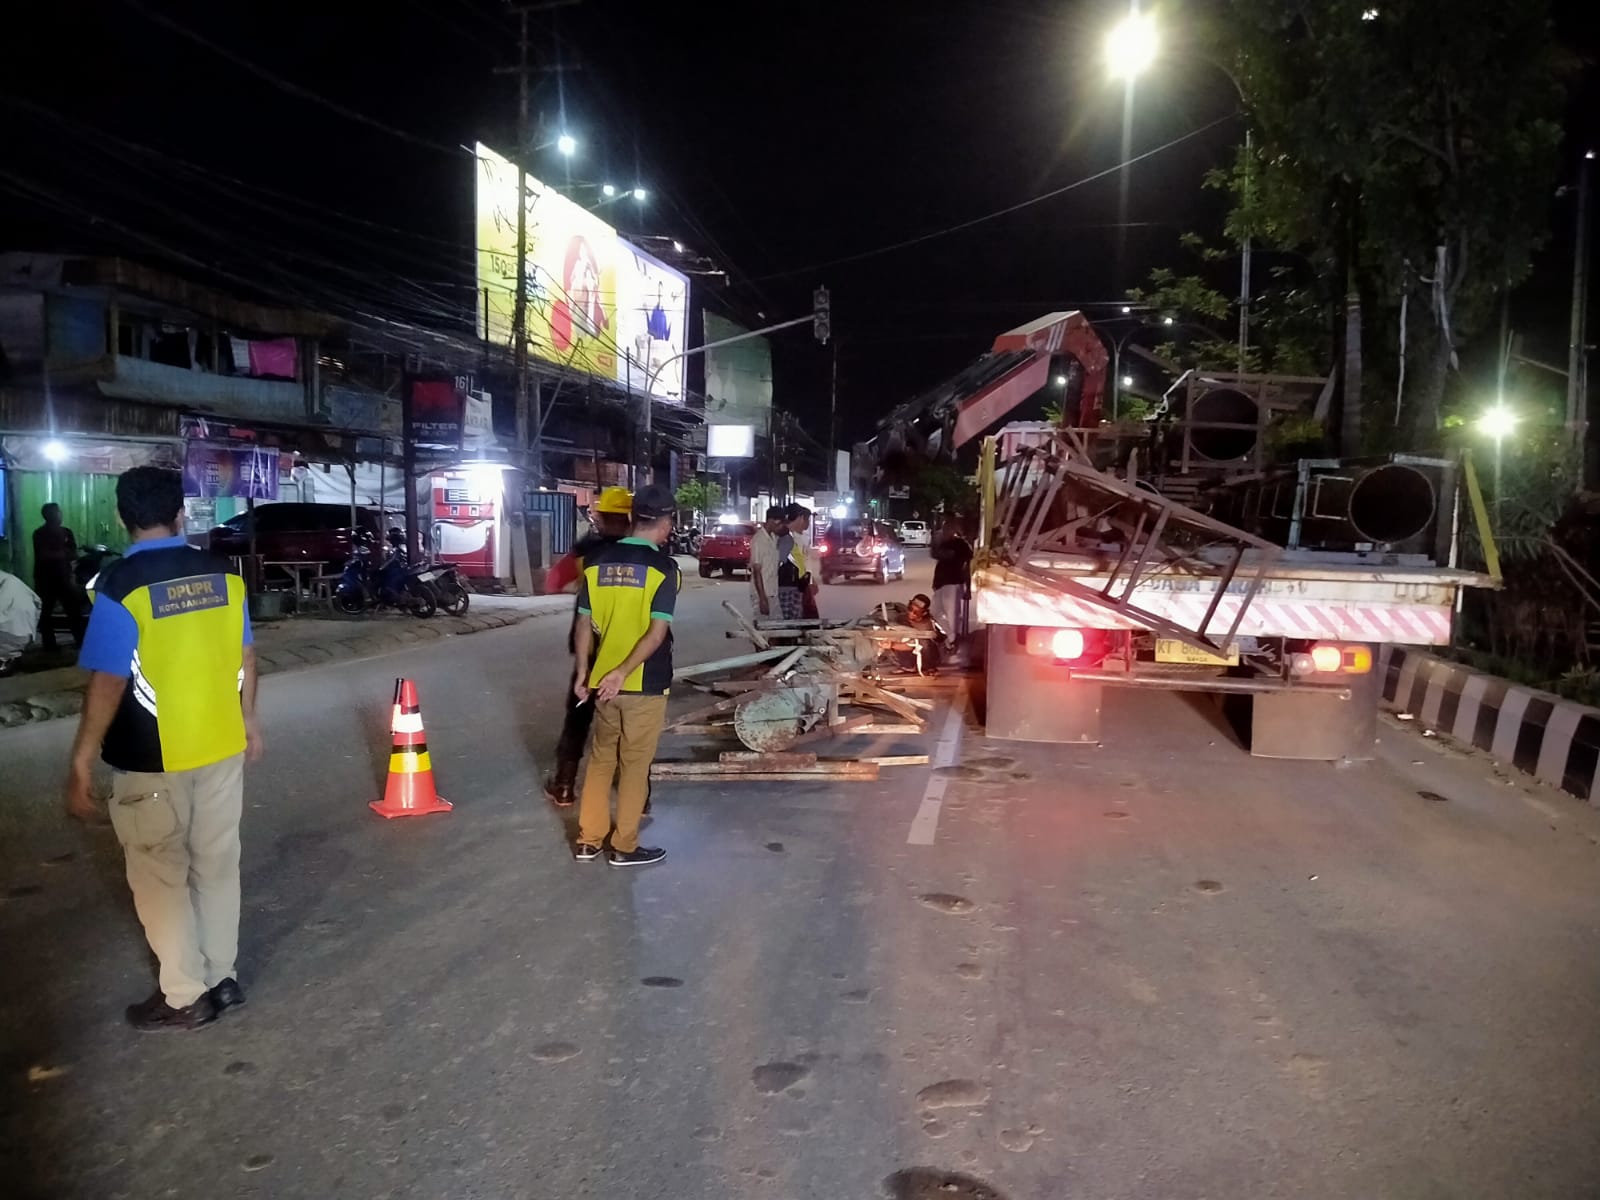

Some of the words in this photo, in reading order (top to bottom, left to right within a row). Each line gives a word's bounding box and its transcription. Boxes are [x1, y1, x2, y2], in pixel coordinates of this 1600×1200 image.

[167, 581, 213, 600] DPUPR
[180, 595, 224, 608] SAMARDA
[1158, 640, 1176, 654] KT
